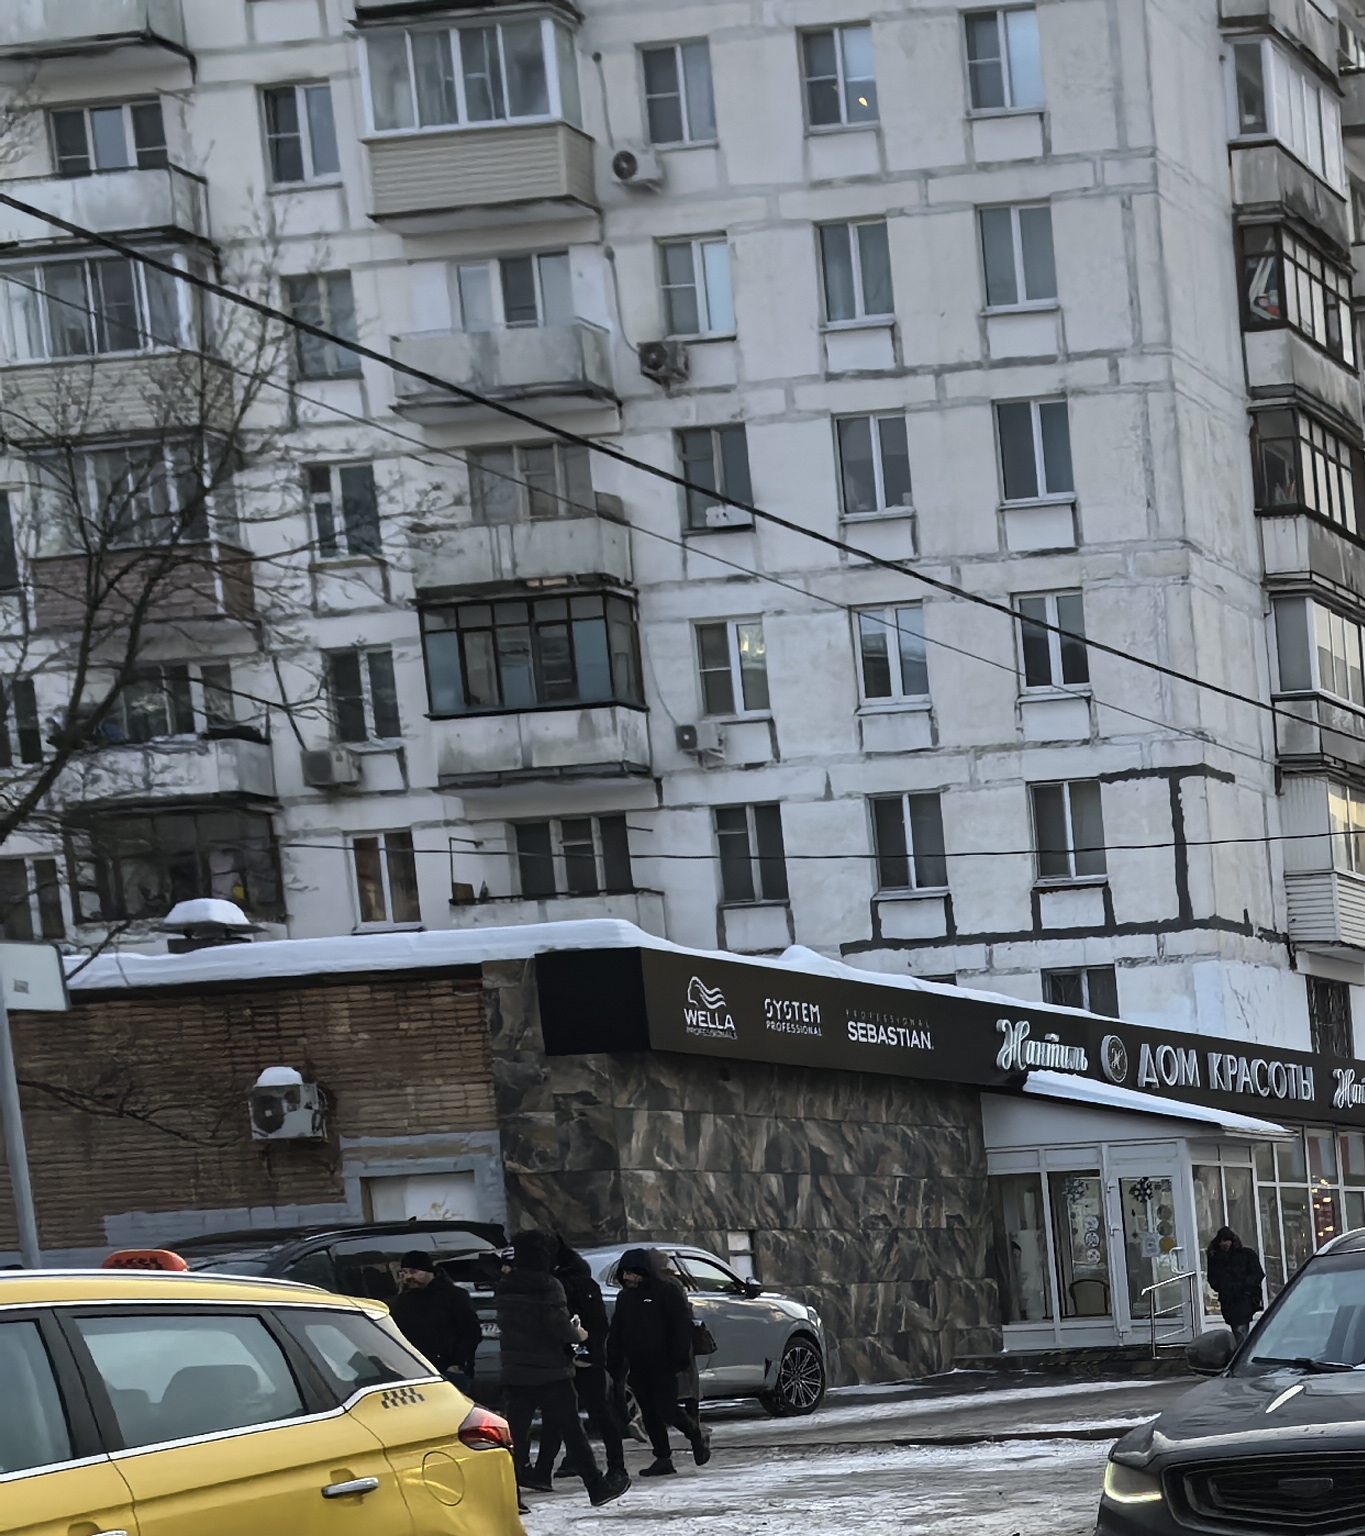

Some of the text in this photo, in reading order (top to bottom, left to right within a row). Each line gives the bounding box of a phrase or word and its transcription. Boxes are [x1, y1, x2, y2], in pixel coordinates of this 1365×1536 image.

[684, 1008, 736, 1031] WELLA
[1137, 1043, 1201, 1090] ДОМ
[1207, 1052, 1315, 1101] КРАСОТЫ
